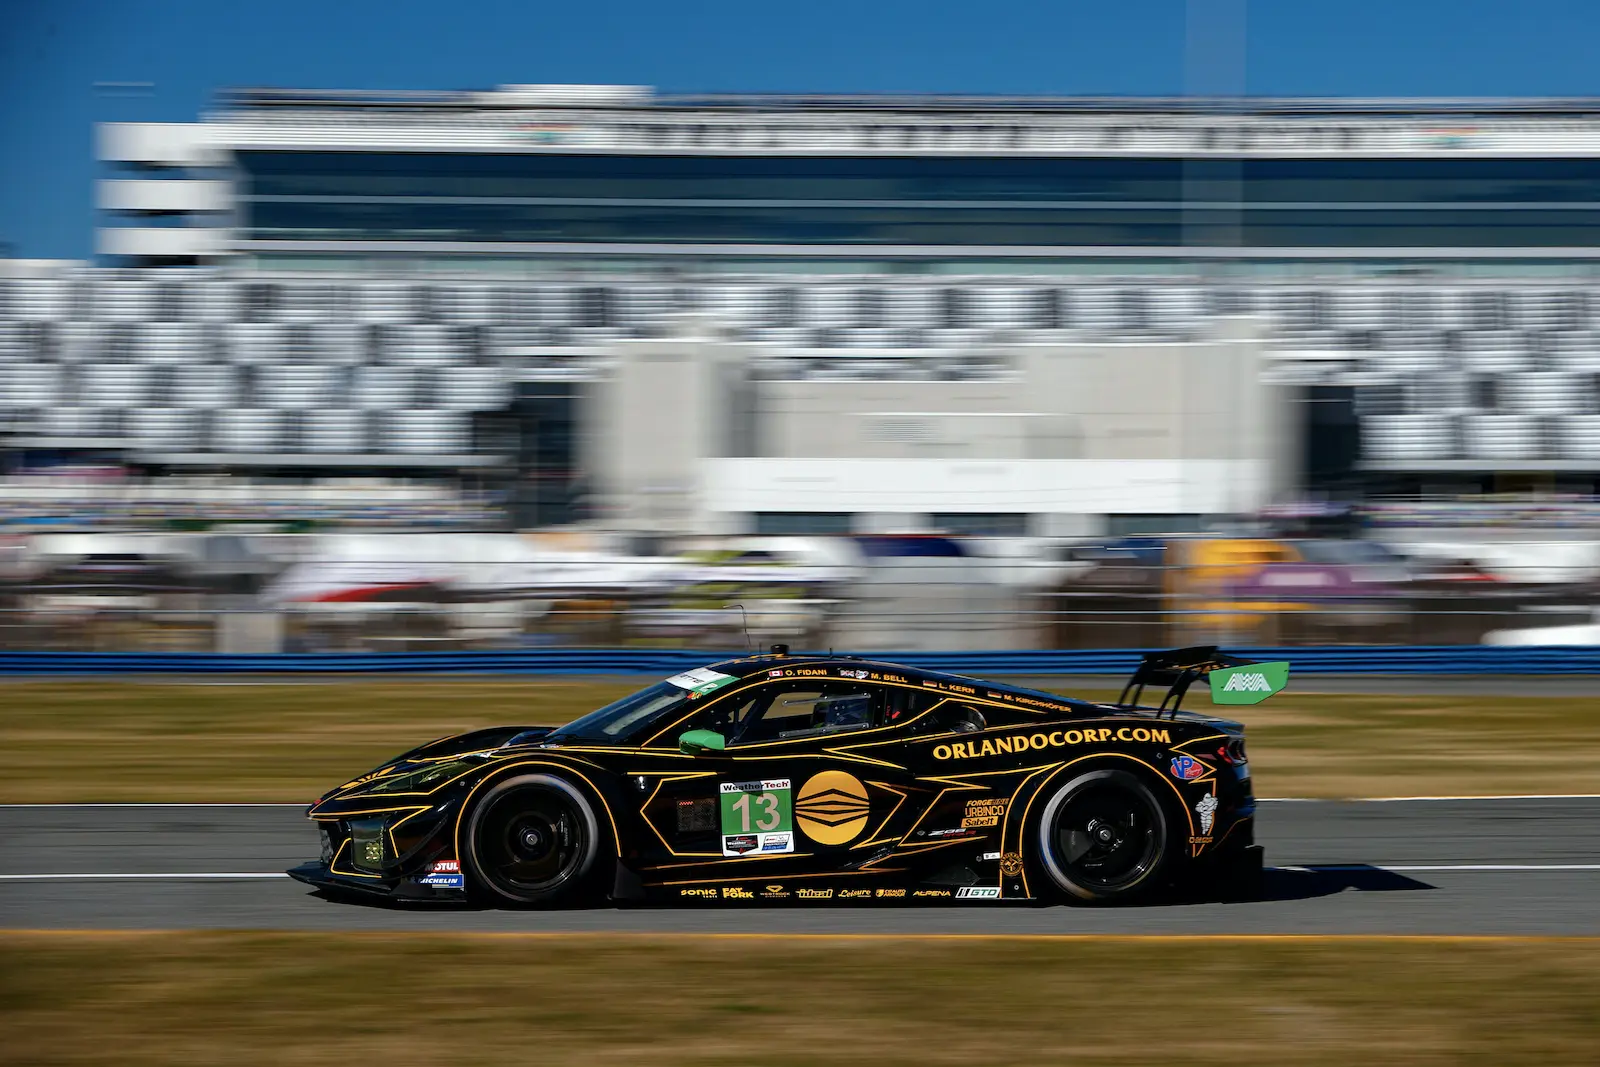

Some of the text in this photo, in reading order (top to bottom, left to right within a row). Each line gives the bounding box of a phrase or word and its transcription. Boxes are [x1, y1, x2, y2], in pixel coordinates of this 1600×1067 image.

[785, 669, 828, 677] O. FIDANI
[871, 672, 908, 683] M. BELL
[949, 684, 975, 695] KERN
[1223, 672, 1272, 692] AWA
[932, 728, 1171, 760] ORLANDOCORP.COM
[1171, 756, 1194, 779] VP
[733, 792, 781, 832] 13
[723, 891, 755, 899] FORK
